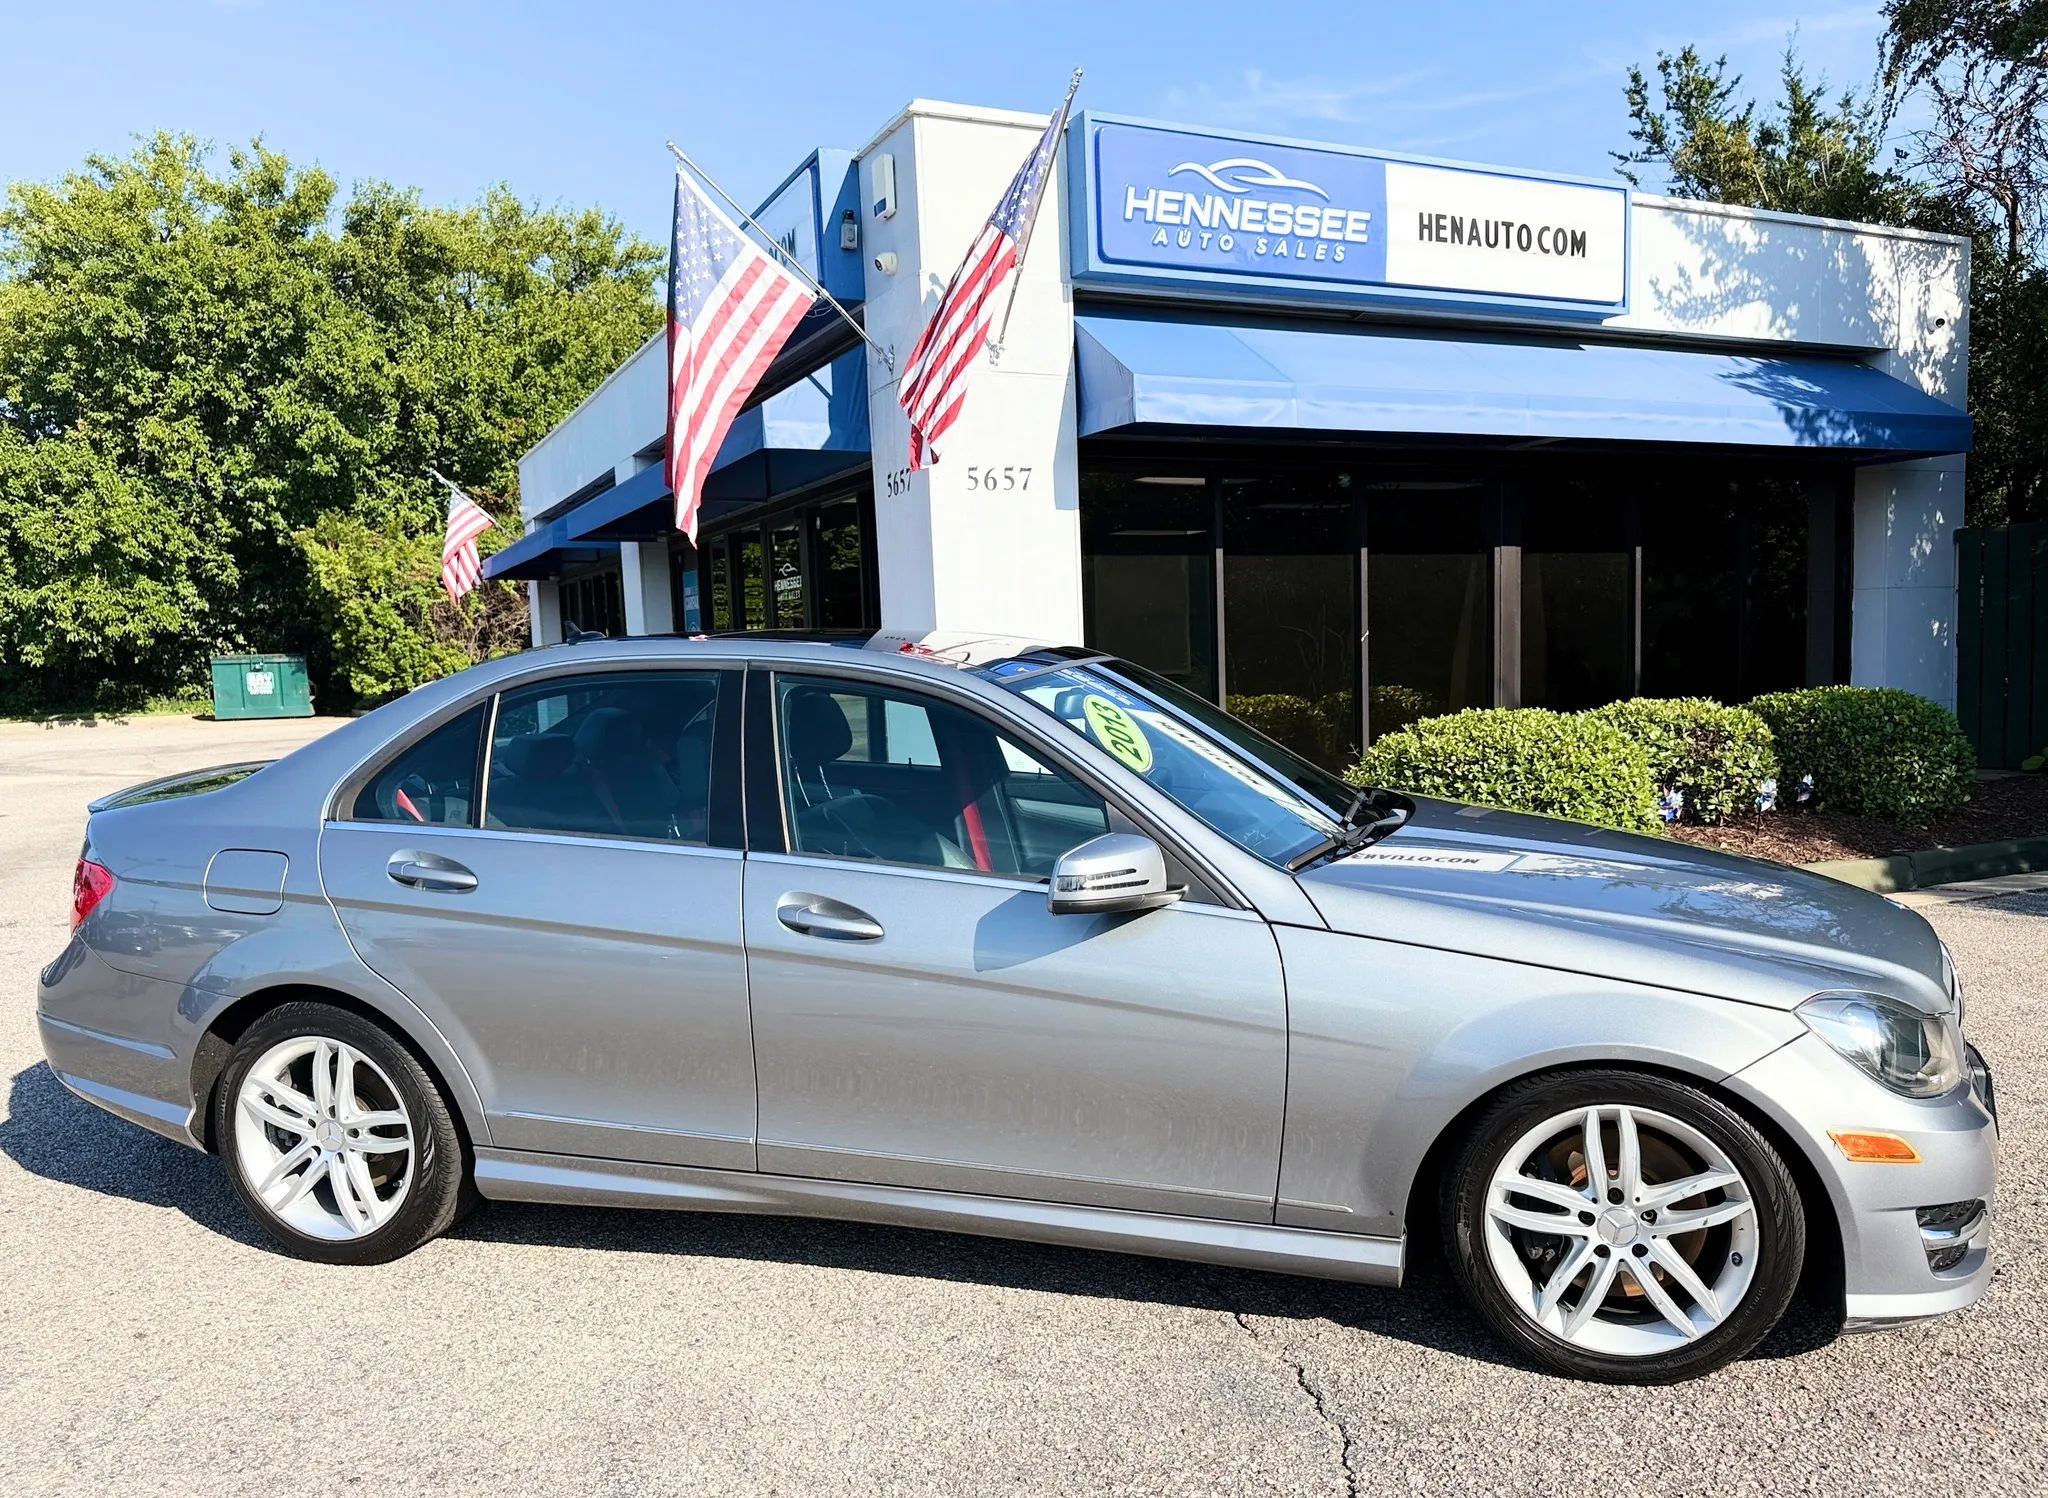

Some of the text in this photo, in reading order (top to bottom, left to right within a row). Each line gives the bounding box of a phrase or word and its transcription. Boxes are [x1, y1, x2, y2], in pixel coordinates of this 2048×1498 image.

[1124, 184, 1371, 243] HENNESSEE
[1153, 226, 1347, 263] AUTO SALES
[887, 468, 912, 498] 5657
[967, 466, 1032, 491] 5657
[1091, 700, 1144, 763] 2013
